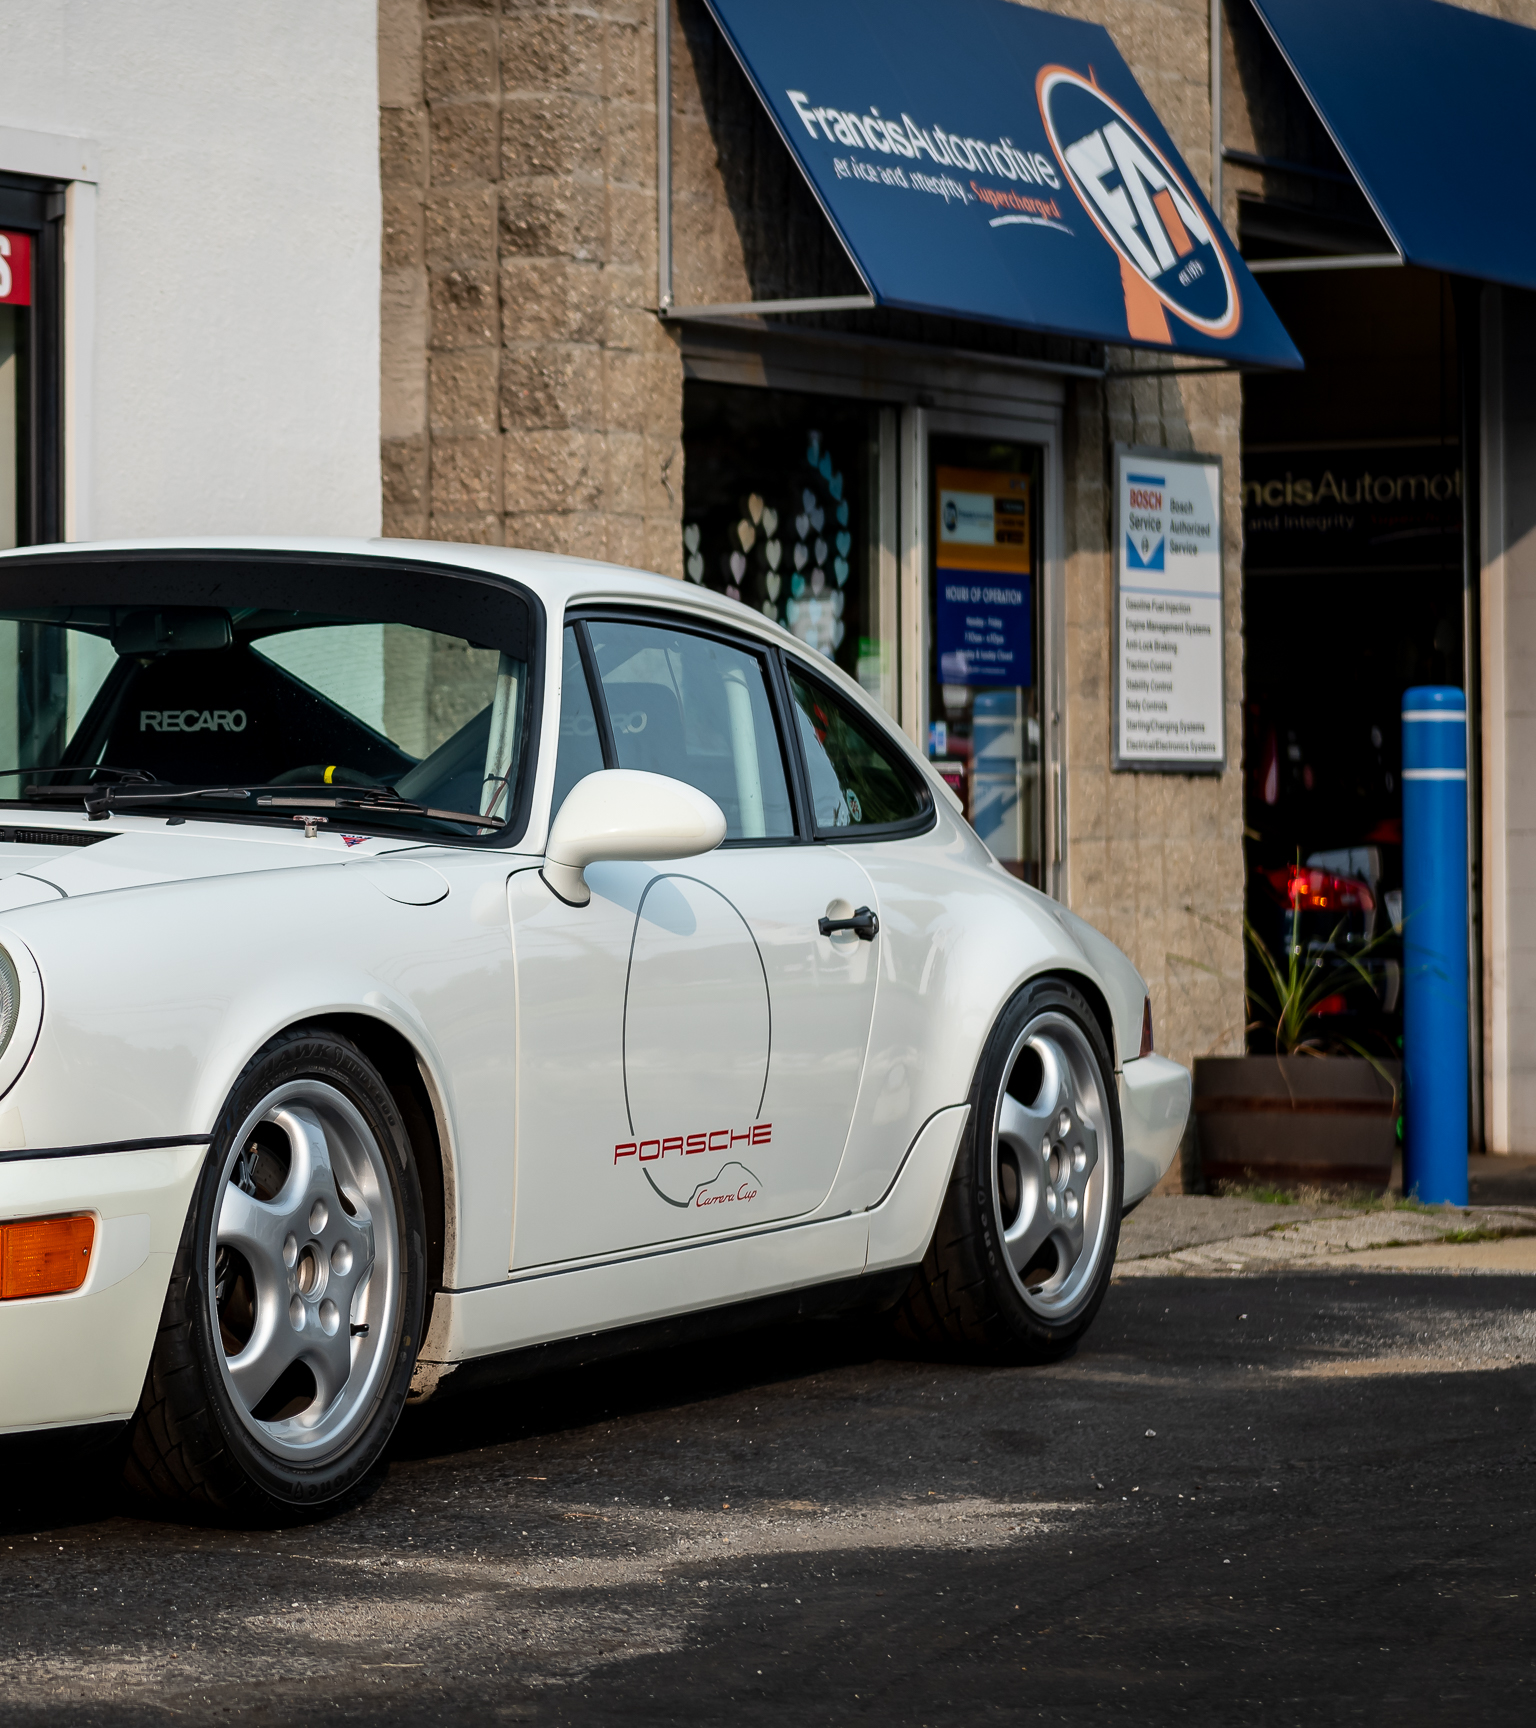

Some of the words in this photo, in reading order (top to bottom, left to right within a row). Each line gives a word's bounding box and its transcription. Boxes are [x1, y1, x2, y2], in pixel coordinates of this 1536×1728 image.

[786, 89, 1062, 190] FrancisAutomotive
[880, 165, 909, 189] and
[969, 179, 1061, 219] Supercharged
[1129, 488, 1163, 511] BOSCH
[1170, 498, 1194, 516] Bosch
[1129, 512, 1162, 533] Service
[1170, 519, 1211, 538] Authorized
[1284, 512, 1355, 534] Integrity
[1170, 539, 1198, 556] Service
[945, 585, 969, 602] HOURS
[970, 587, 982, 603] OF
[982, 588, 1022, 605] OPERATION
[1125, 598, 1151, 612] Gasoline
[1152, 599, 1165, 613] Fuel
[1165, 600, 1191, 615] Injection
[1125, 617, 1145, 633] Engine
[1146, 620, 1184, 634] Management
[1185, 623, 1211, 637] Systems
[1154, 640, 1177, 655] Braking
[1125, 658, 1149, 671] Traction
[1150, 659, 1172, 672] Control
[1125, 677, 1149, 693] Stability
[1150, 678, 1172, 692] Control
[1125, 699, 1141, 713] Body
[1142, 698, 1167, 712] Controls
[140, 709, 247, 732] RECARO
[1179, 720, 1205, 734] Systems
[1190, 739, 1216, 754] Systems
[614, 1123, 772, 1165] PORSCHE
[696, 1189, 735, 1207] Carrera
[737, 1182, 757, 1202] Cup
